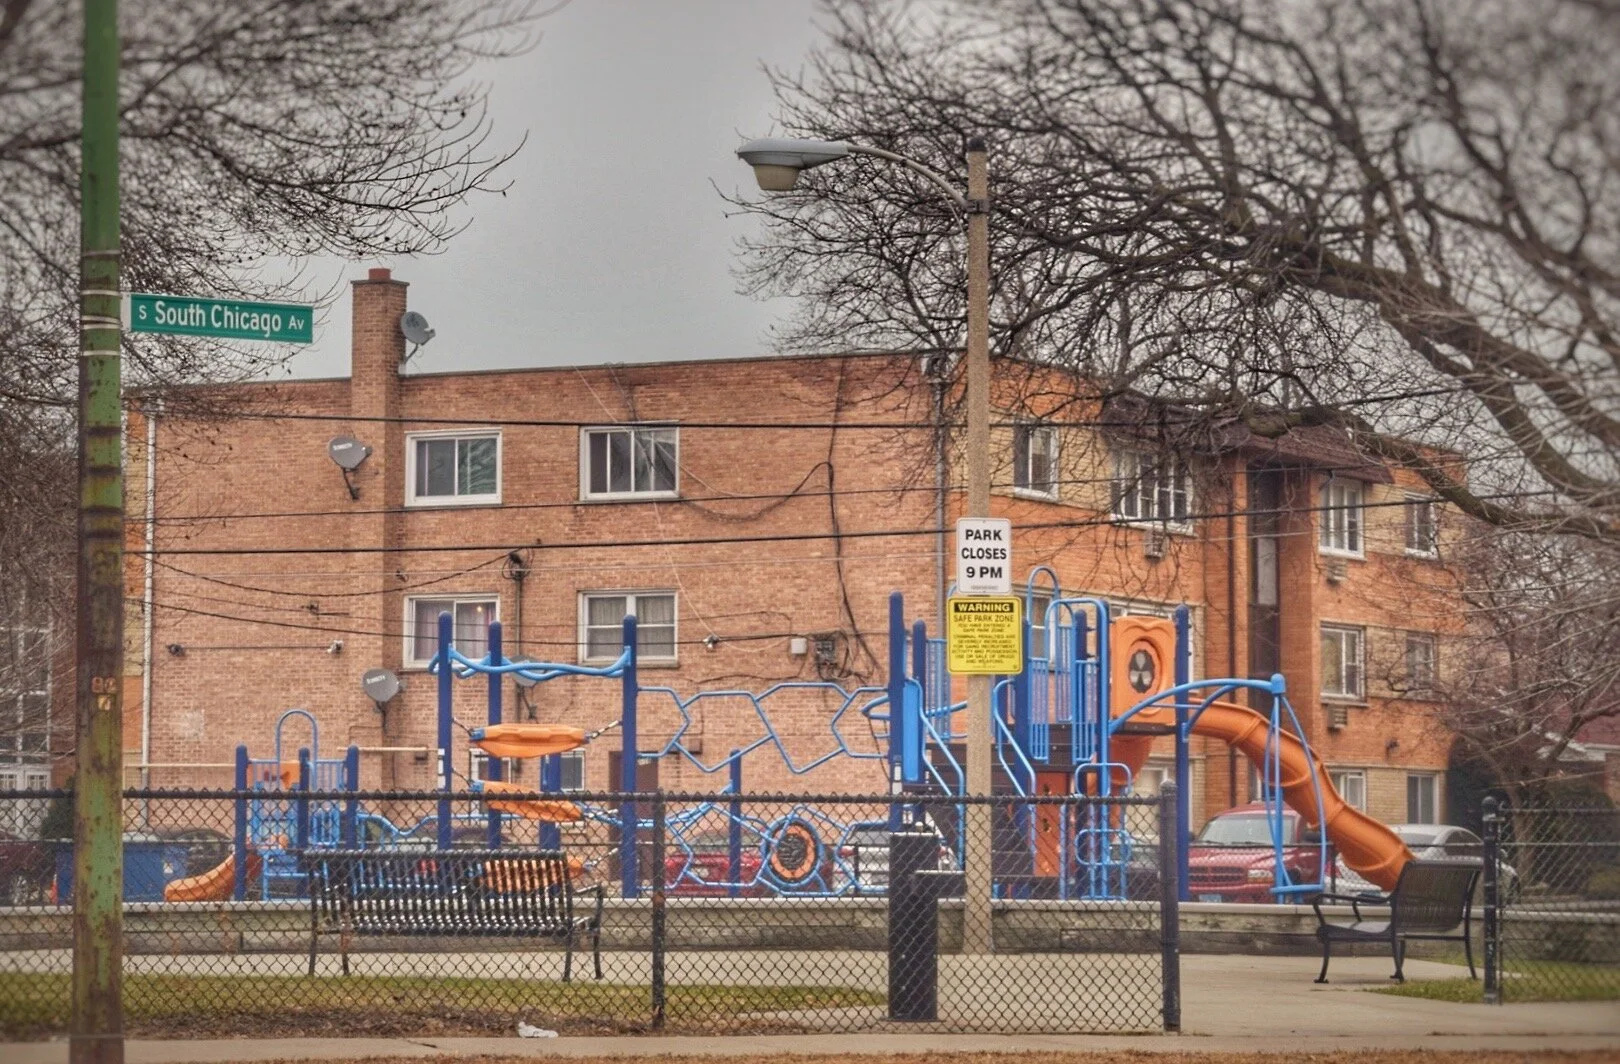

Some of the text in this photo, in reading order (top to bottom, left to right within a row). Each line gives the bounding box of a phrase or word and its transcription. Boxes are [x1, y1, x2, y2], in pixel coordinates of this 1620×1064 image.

[138, 300, 304, 338] S South Chicago Av
[965, 529, 1002, 540] PARK
[961, 548, 1007, 559] CLOSES
[966, 566, 1002, 578] 9 PM
[958, 604, 1010, 612] WARNING
